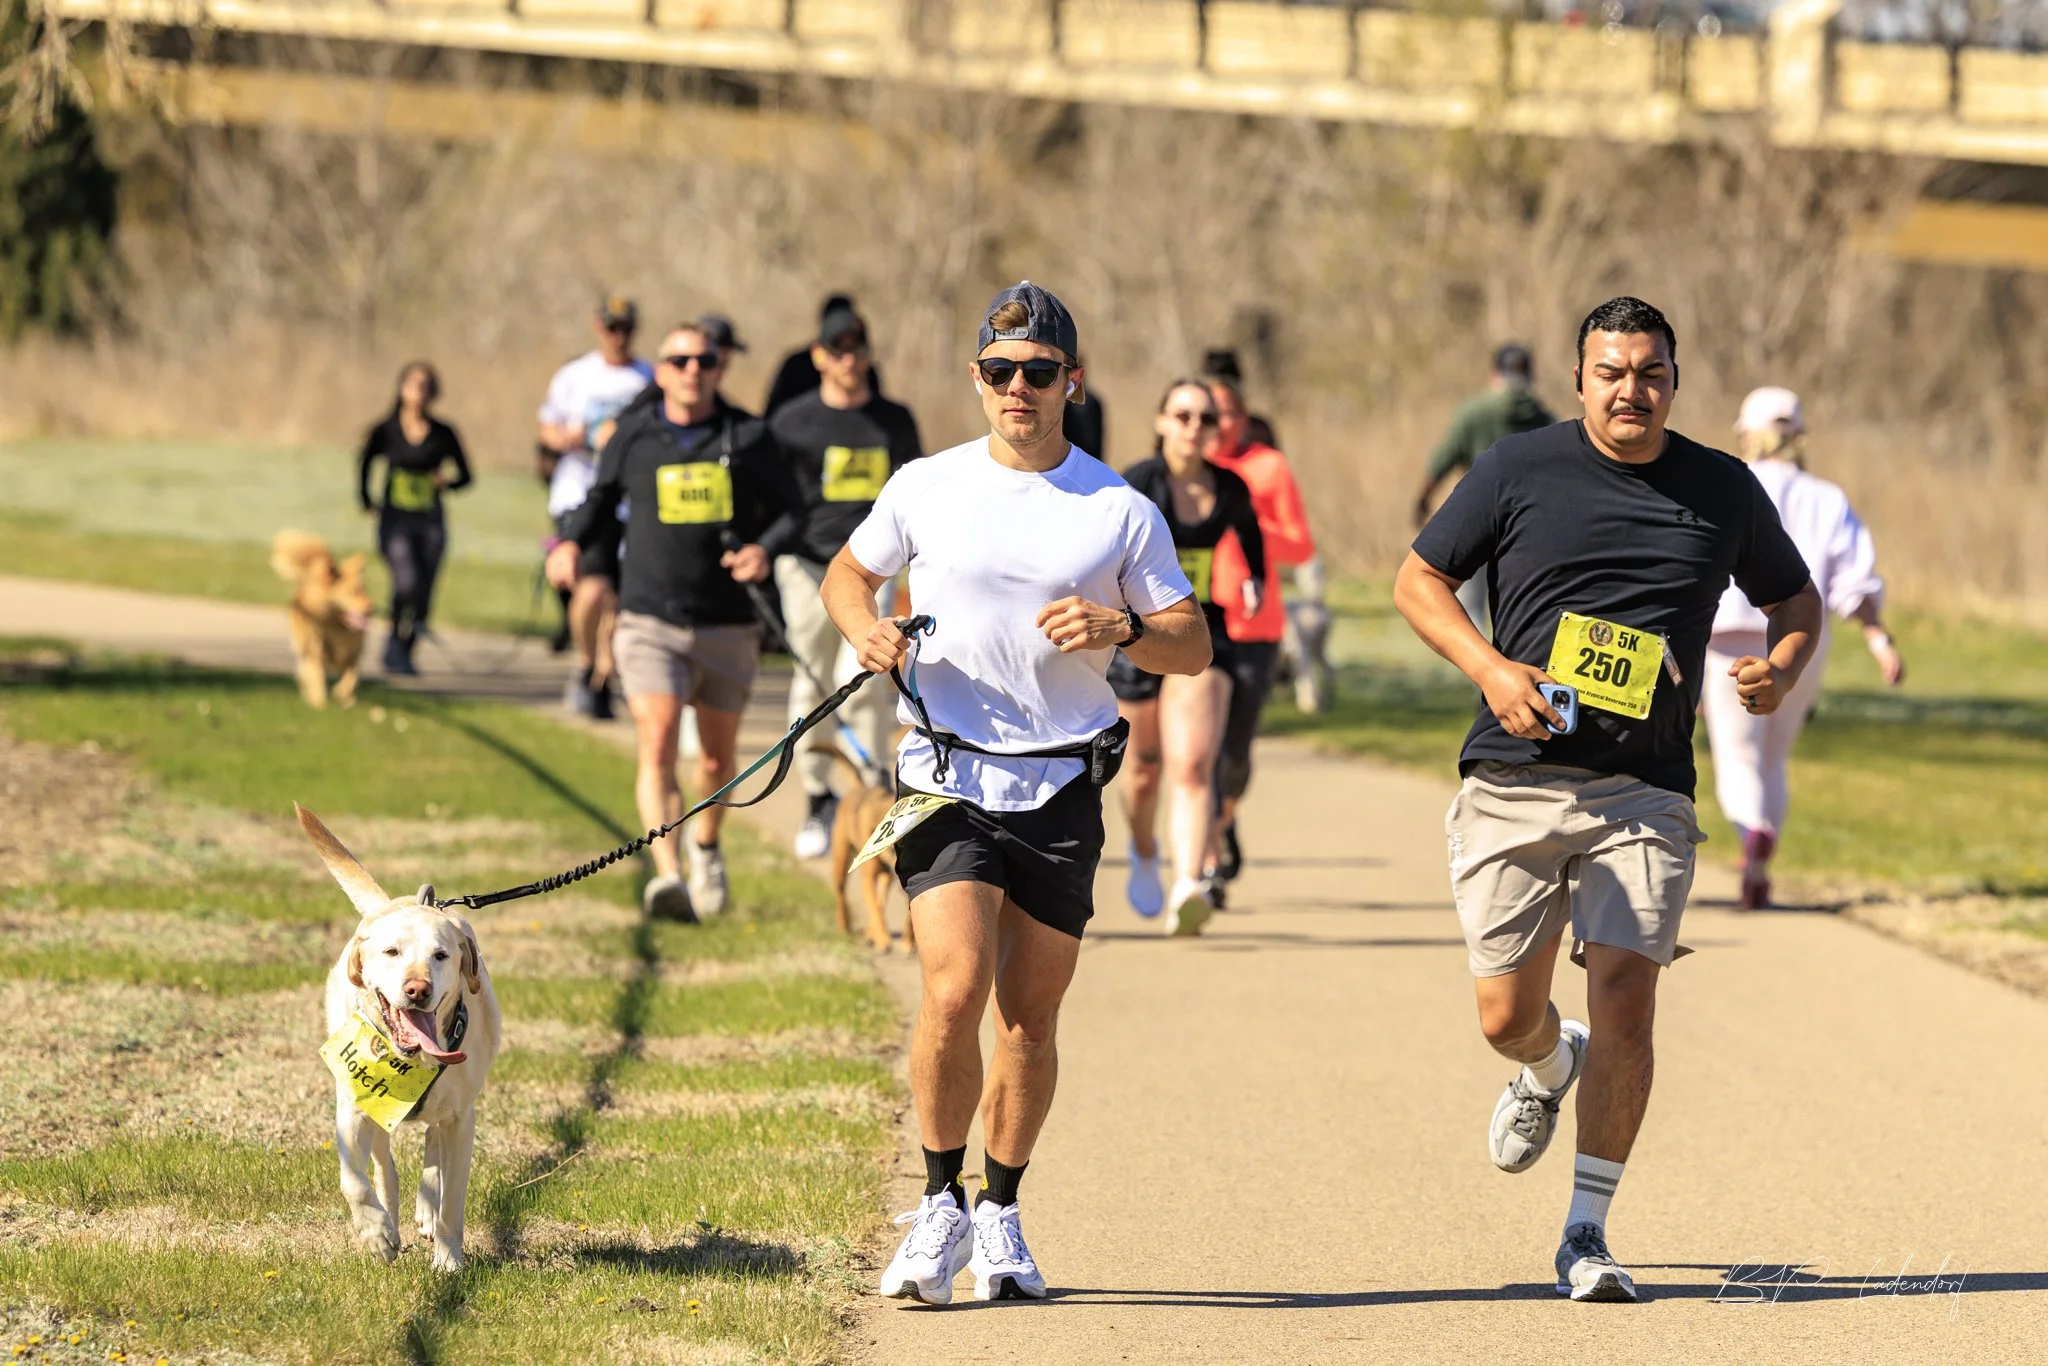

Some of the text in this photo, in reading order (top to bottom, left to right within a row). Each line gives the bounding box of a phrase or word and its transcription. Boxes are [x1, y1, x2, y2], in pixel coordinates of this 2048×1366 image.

[1617, 631, 1641, 652] 5K
[1574, 647, 1632, 688] 250
[909, 796, 932, 808] 5K
[339, 1041, 390, 1098] Hotch
[389, 1057, 413, 1076] 5K
